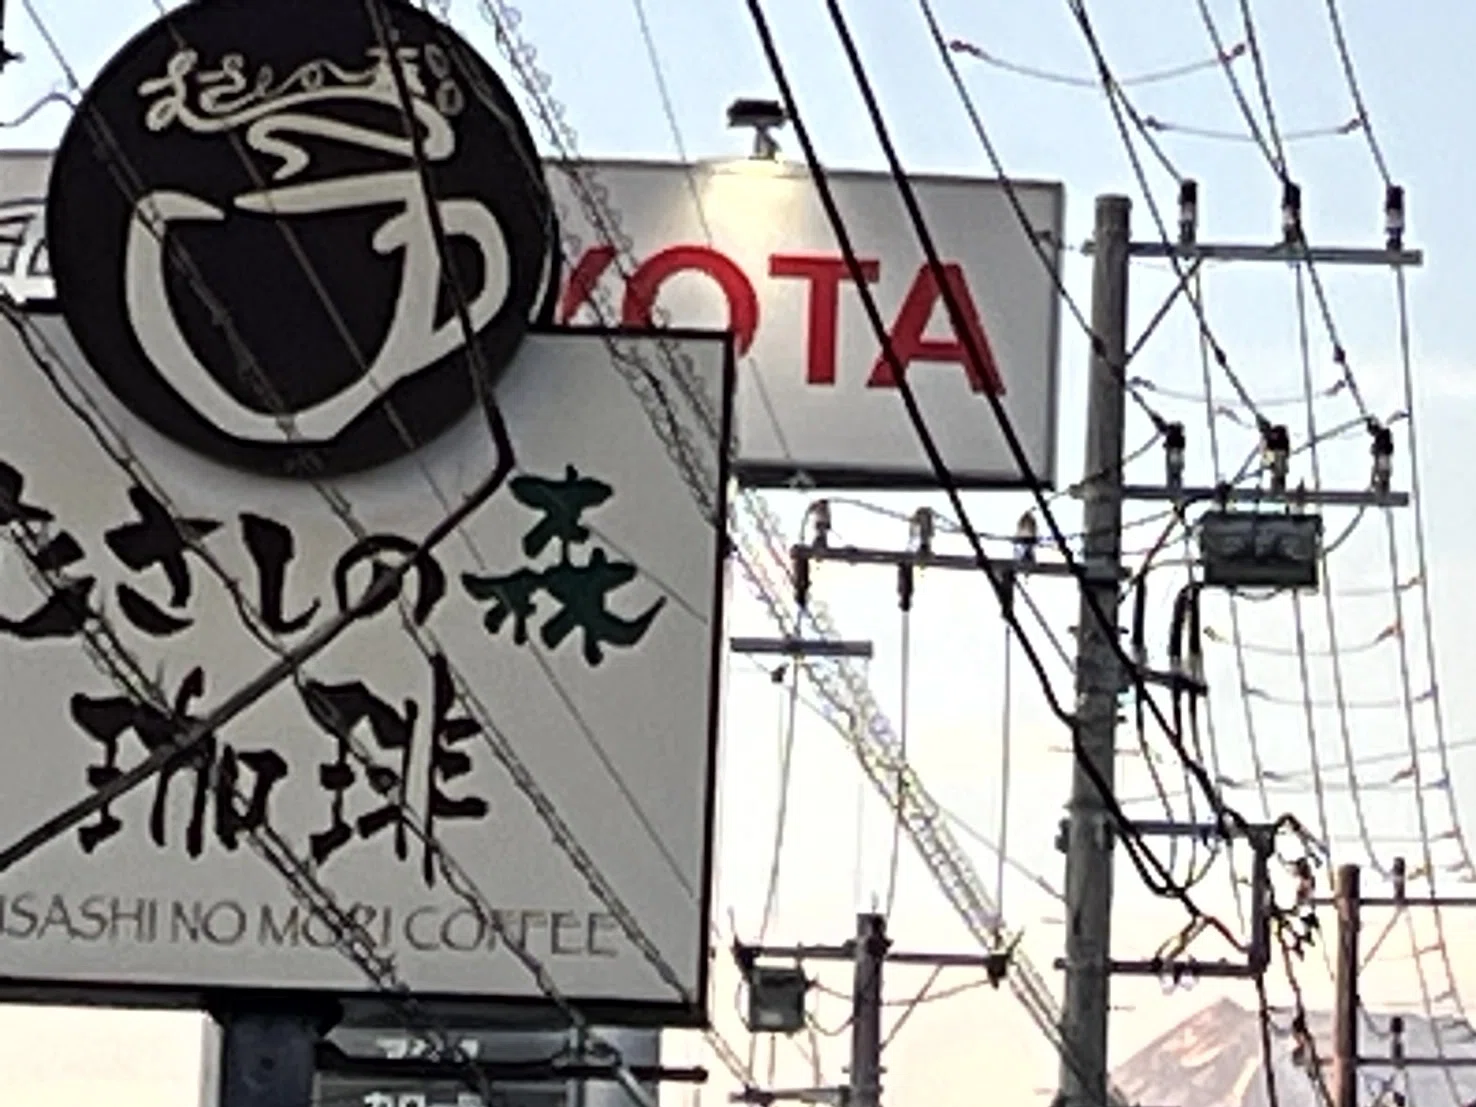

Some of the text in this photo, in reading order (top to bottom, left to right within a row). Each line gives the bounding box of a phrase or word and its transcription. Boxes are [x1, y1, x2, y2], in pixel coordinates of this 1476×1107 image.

[70, 652, 490, 890] 珈琲
[0, 892, 620, 958] SASHI NO MORI COFFEE
